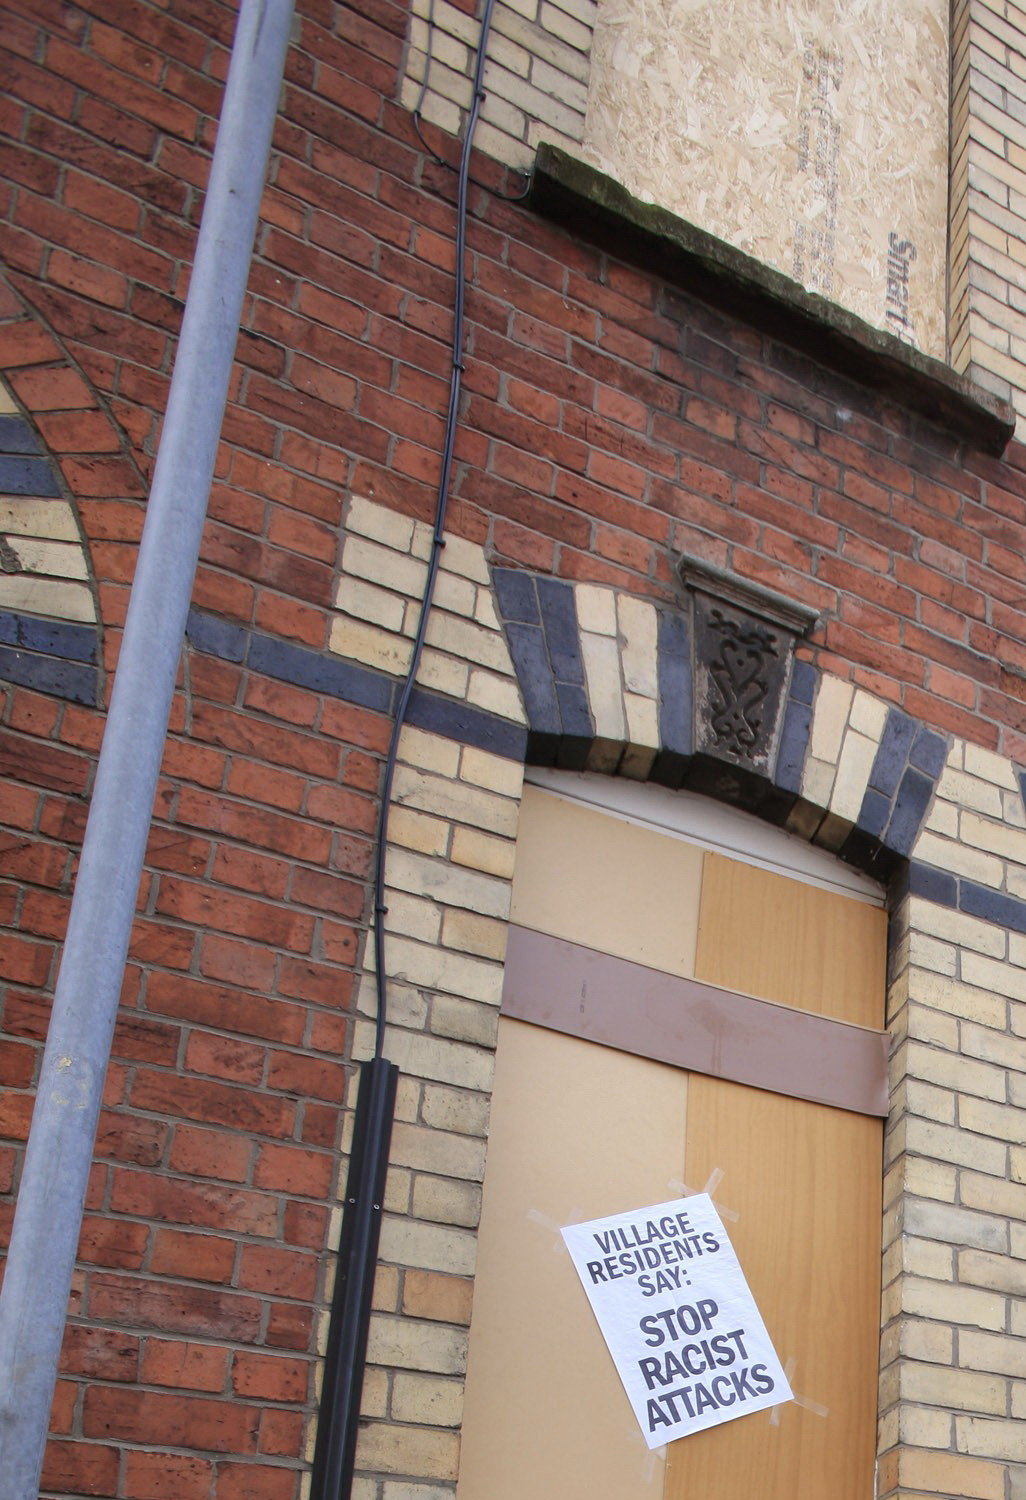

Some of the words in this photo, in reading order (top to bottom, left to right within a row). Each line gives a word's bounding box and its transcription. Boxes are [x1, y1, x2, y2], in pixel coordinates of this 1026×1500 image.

[586, 1232, 720, 1285] RESIDENTS
[593, 1212, 695, 1255] VILLAGE
[637, 1266, 692, 1297] SAY:
[639, 1299, 719, 1347] STOP
[638, 1329, 749, 1391] RACIST
[646, 1363, 775, 1432] ATTACKS
